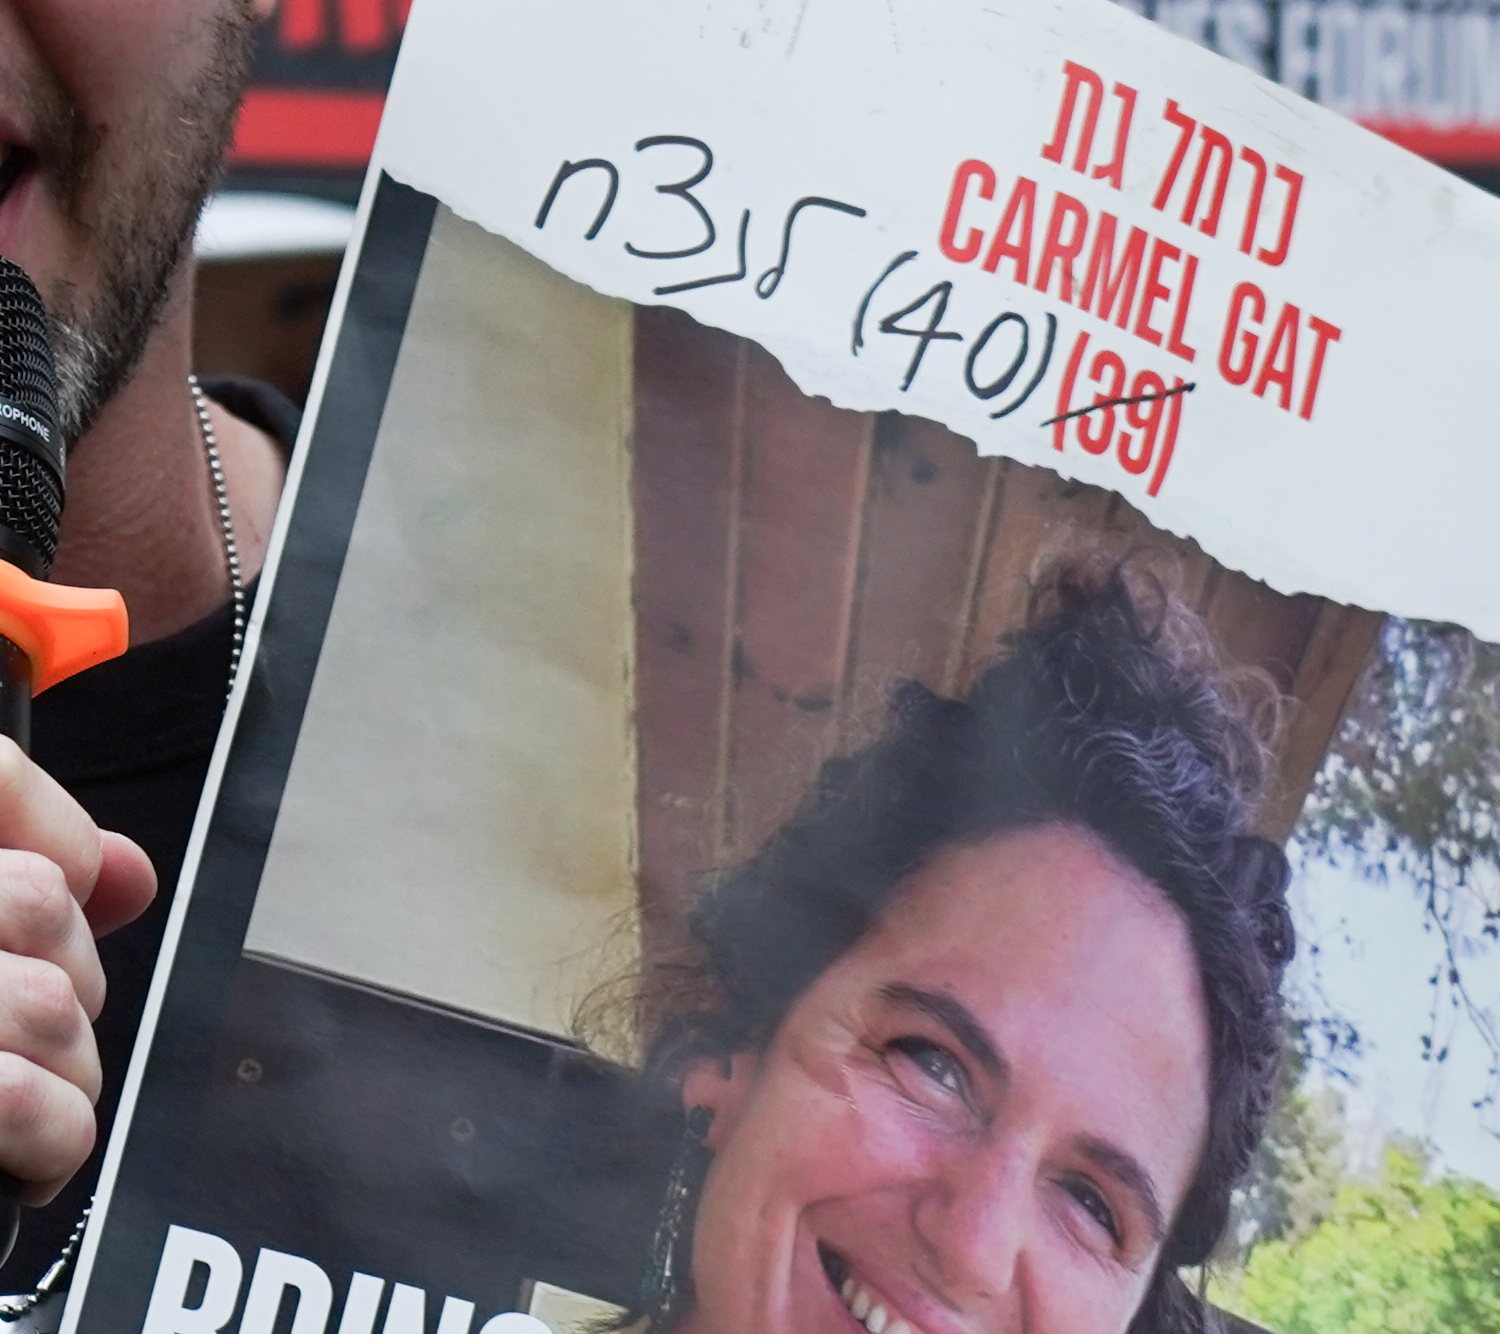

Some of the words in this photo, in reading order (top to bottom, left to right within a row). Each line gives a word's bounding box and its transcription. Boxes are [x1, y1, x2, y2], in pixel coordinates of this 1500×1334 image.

[1039, 58, 1138, 192] גת
[1150, 97, 1305, 269] כרמל
[850, 250, 1058, 421] (40)
[937, 157, 1201, 364] CARMEL
[1215, 280, 1343, 422] GAT
[1050, 329, 1188, 498] (39)
